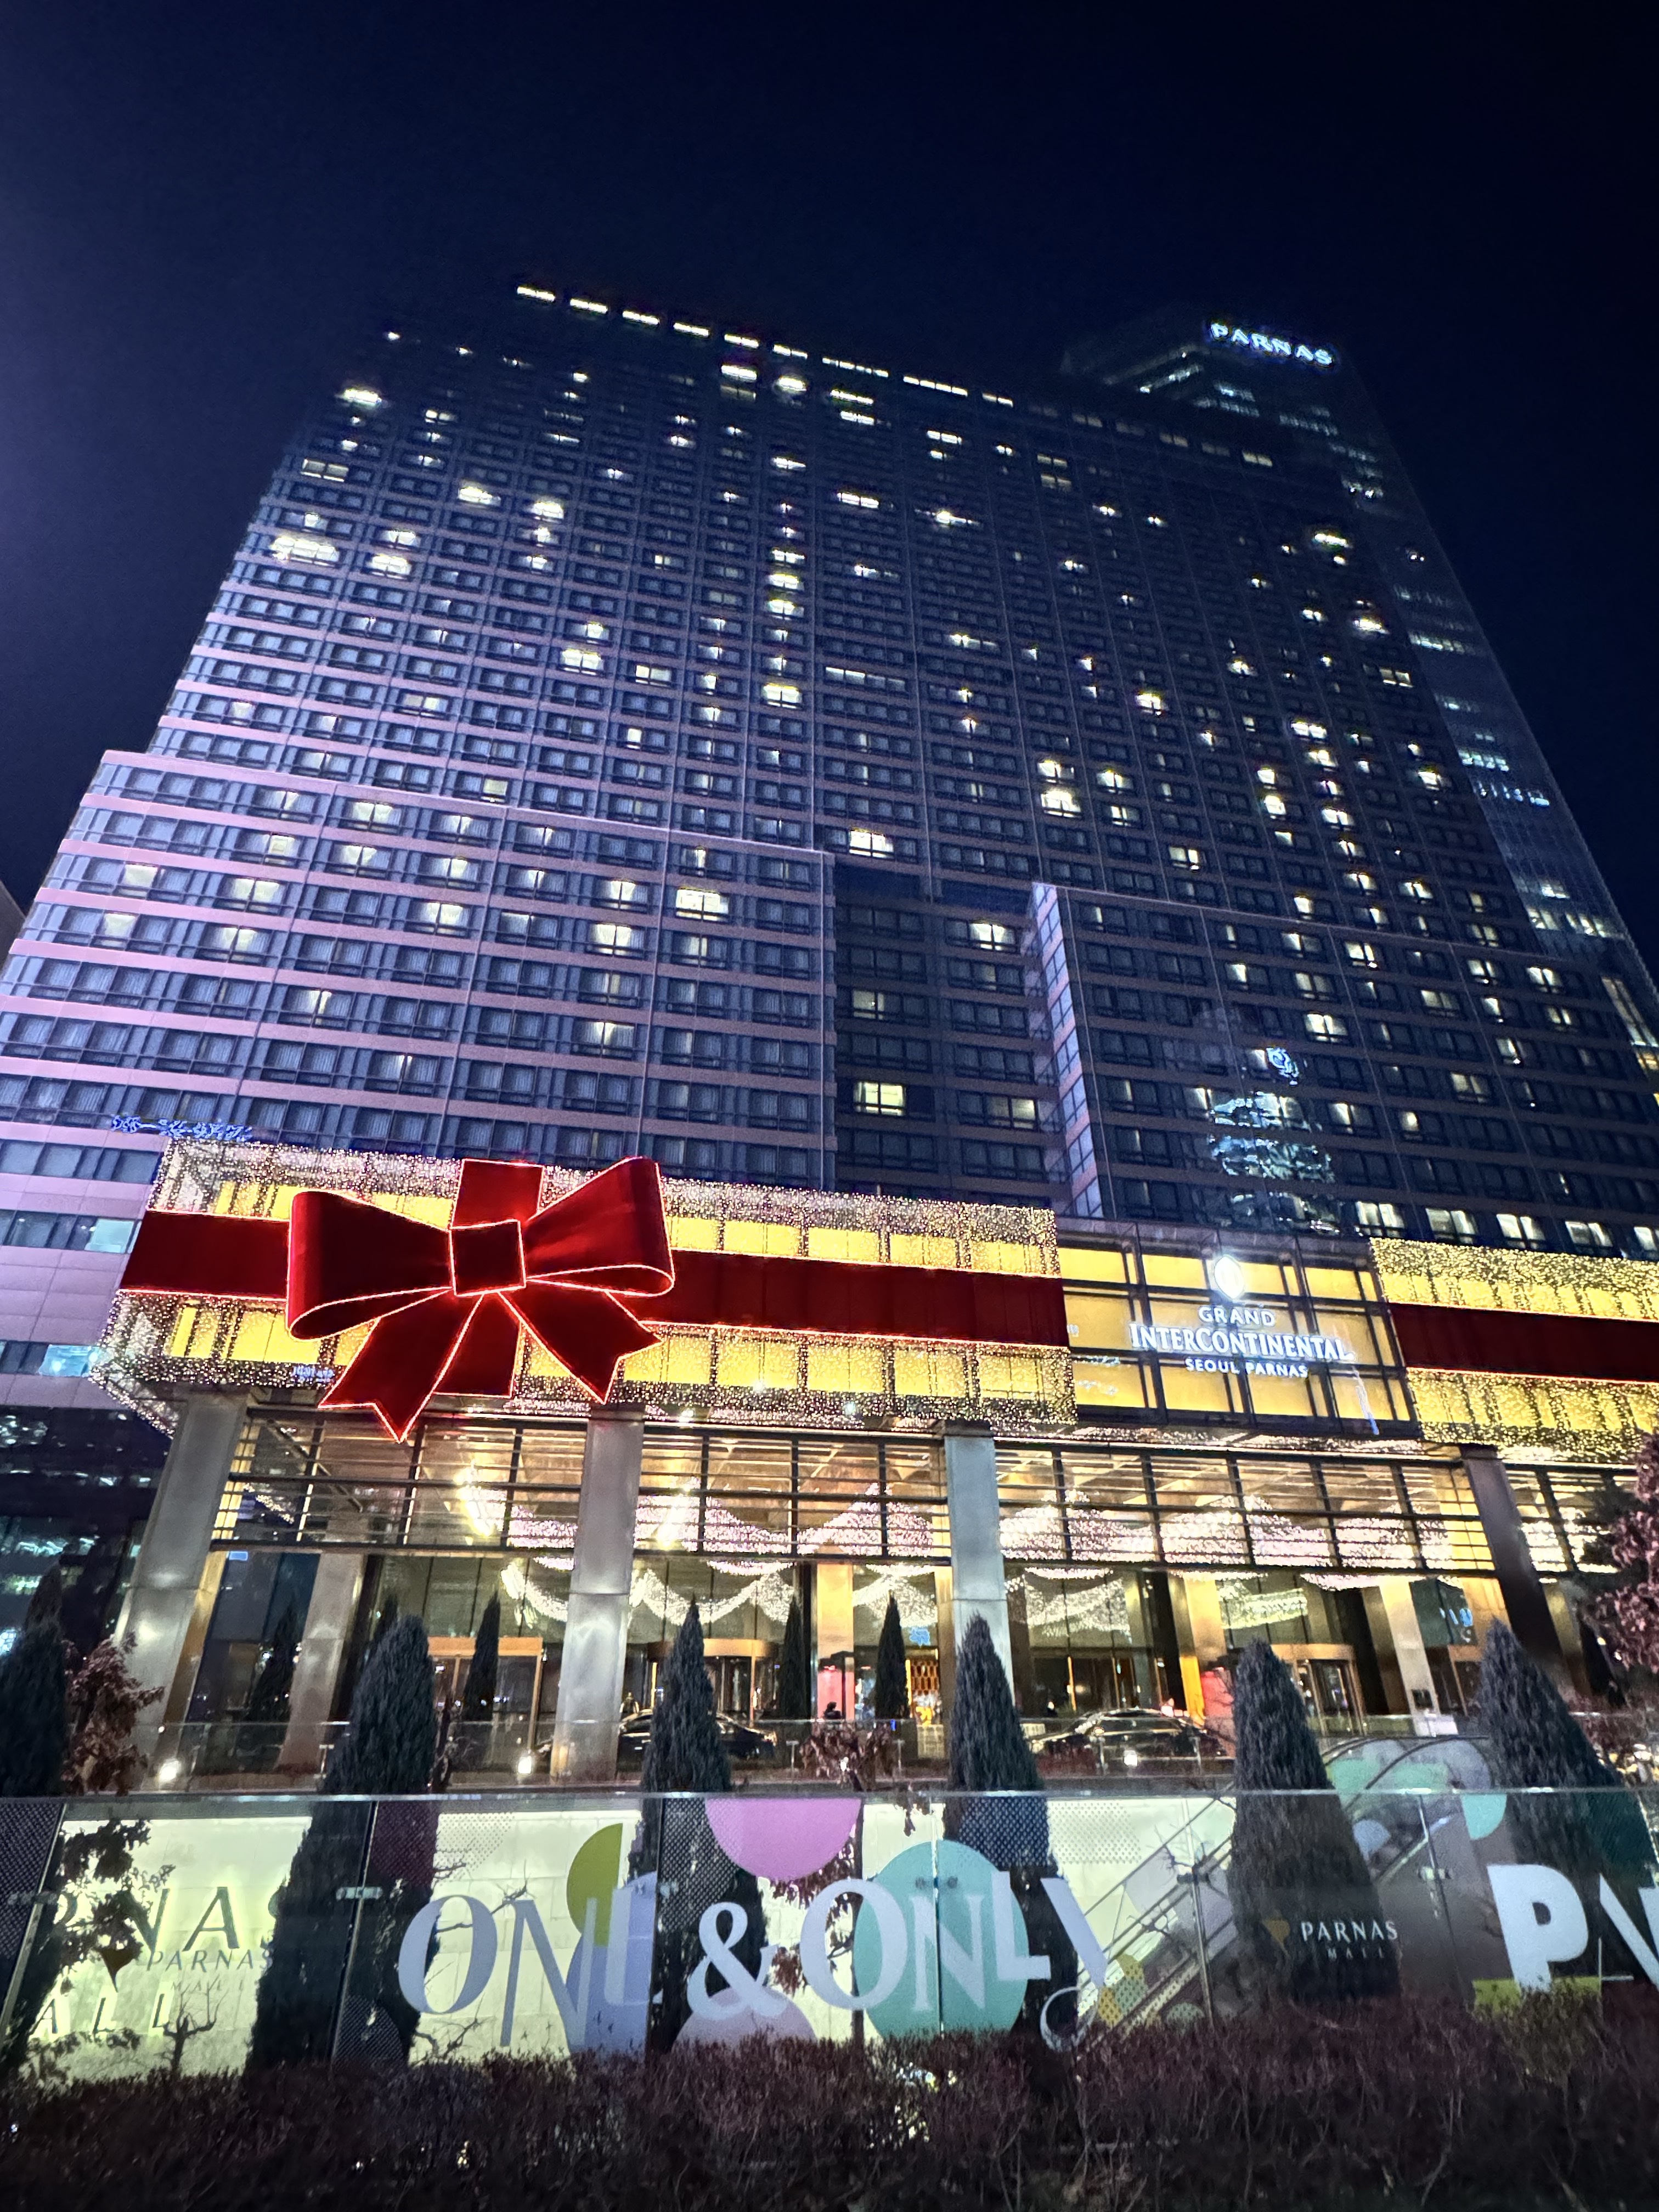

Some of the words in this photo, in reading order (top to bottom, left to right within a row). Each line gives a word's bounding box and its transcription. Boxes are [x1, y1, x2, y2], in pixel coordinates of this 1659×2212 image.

[1210, 323, 1333, 366] PARNAS
[1198, 1306, 1276, 1327] GRAND
[1129, 1322, 1356, 1362] INTERCONTINENTAL
[1185, 1357, 1240, 1375] SEOUL
[1245, 1361, 1308, 1378] PARNAS
[1300, 1919, 1398, 1944] PARNAS
[146, 1949, 274, 1973] PARNAS
